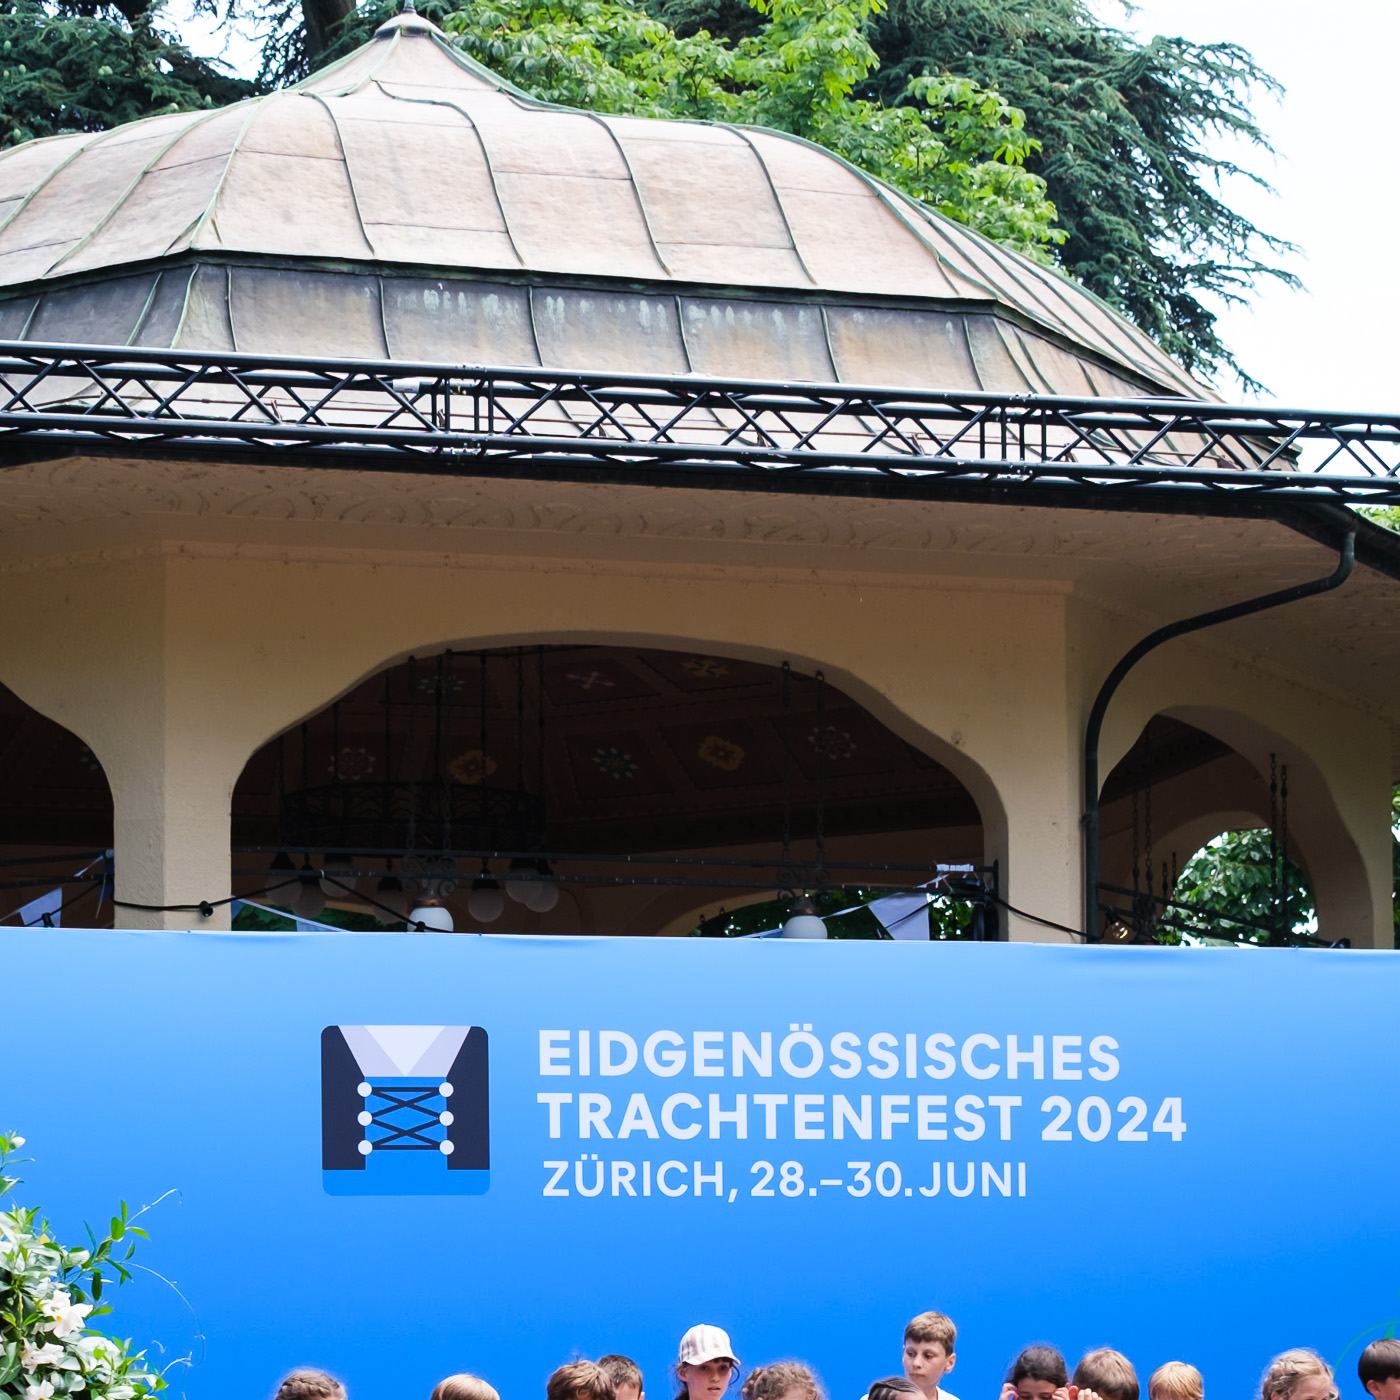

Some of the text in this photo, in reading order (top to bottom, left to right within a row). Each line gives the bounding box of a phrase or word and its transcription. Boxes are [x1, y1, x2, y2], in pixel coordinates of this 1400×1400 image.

[537, 1023, 1120, 1079] EIDGENÖSSISCHES
[537, 1092, 1188, 1142] TRACHTENFEST 2024
[542, 1154, 737, 1203] ZÜRICH,
